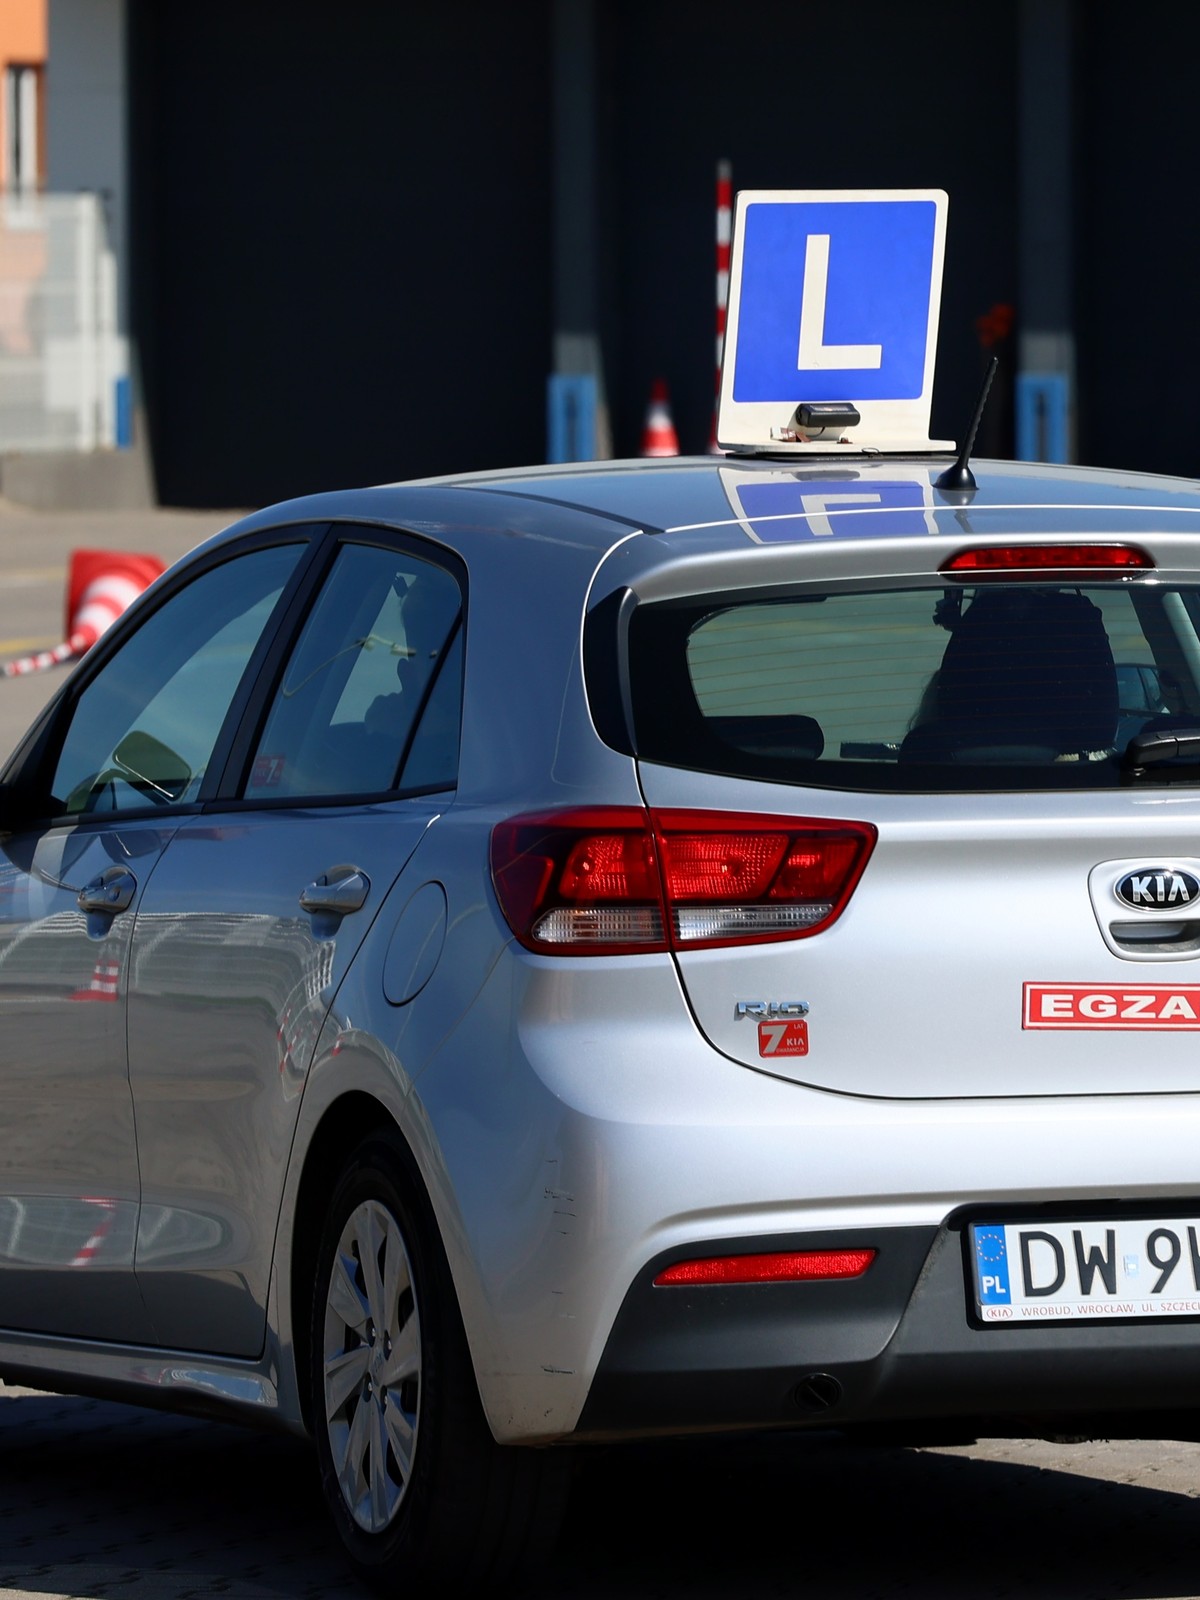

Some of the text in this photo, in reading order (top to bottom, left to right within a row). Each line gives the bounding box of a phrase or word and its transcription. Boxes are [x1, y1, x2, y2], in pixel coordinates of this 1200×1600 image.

[797, 234, 882, 370] L
[1130, 875, 1191, 903] KIA
[737, 1000, 810, 1017] RIO
[761, 1024, 788, 1054] 7
[786, 1038, 804, 1046] KIA
[1018, 1228, 1118, 1298] DW
[982, 1275, 1006, 1294] PL
[1021, 1306, 1074, 1317] WROBUD,
[1077, 1303, 1136, 1315] WROCŁAW,
[1141, 1303, 1158, 1313] UL.
